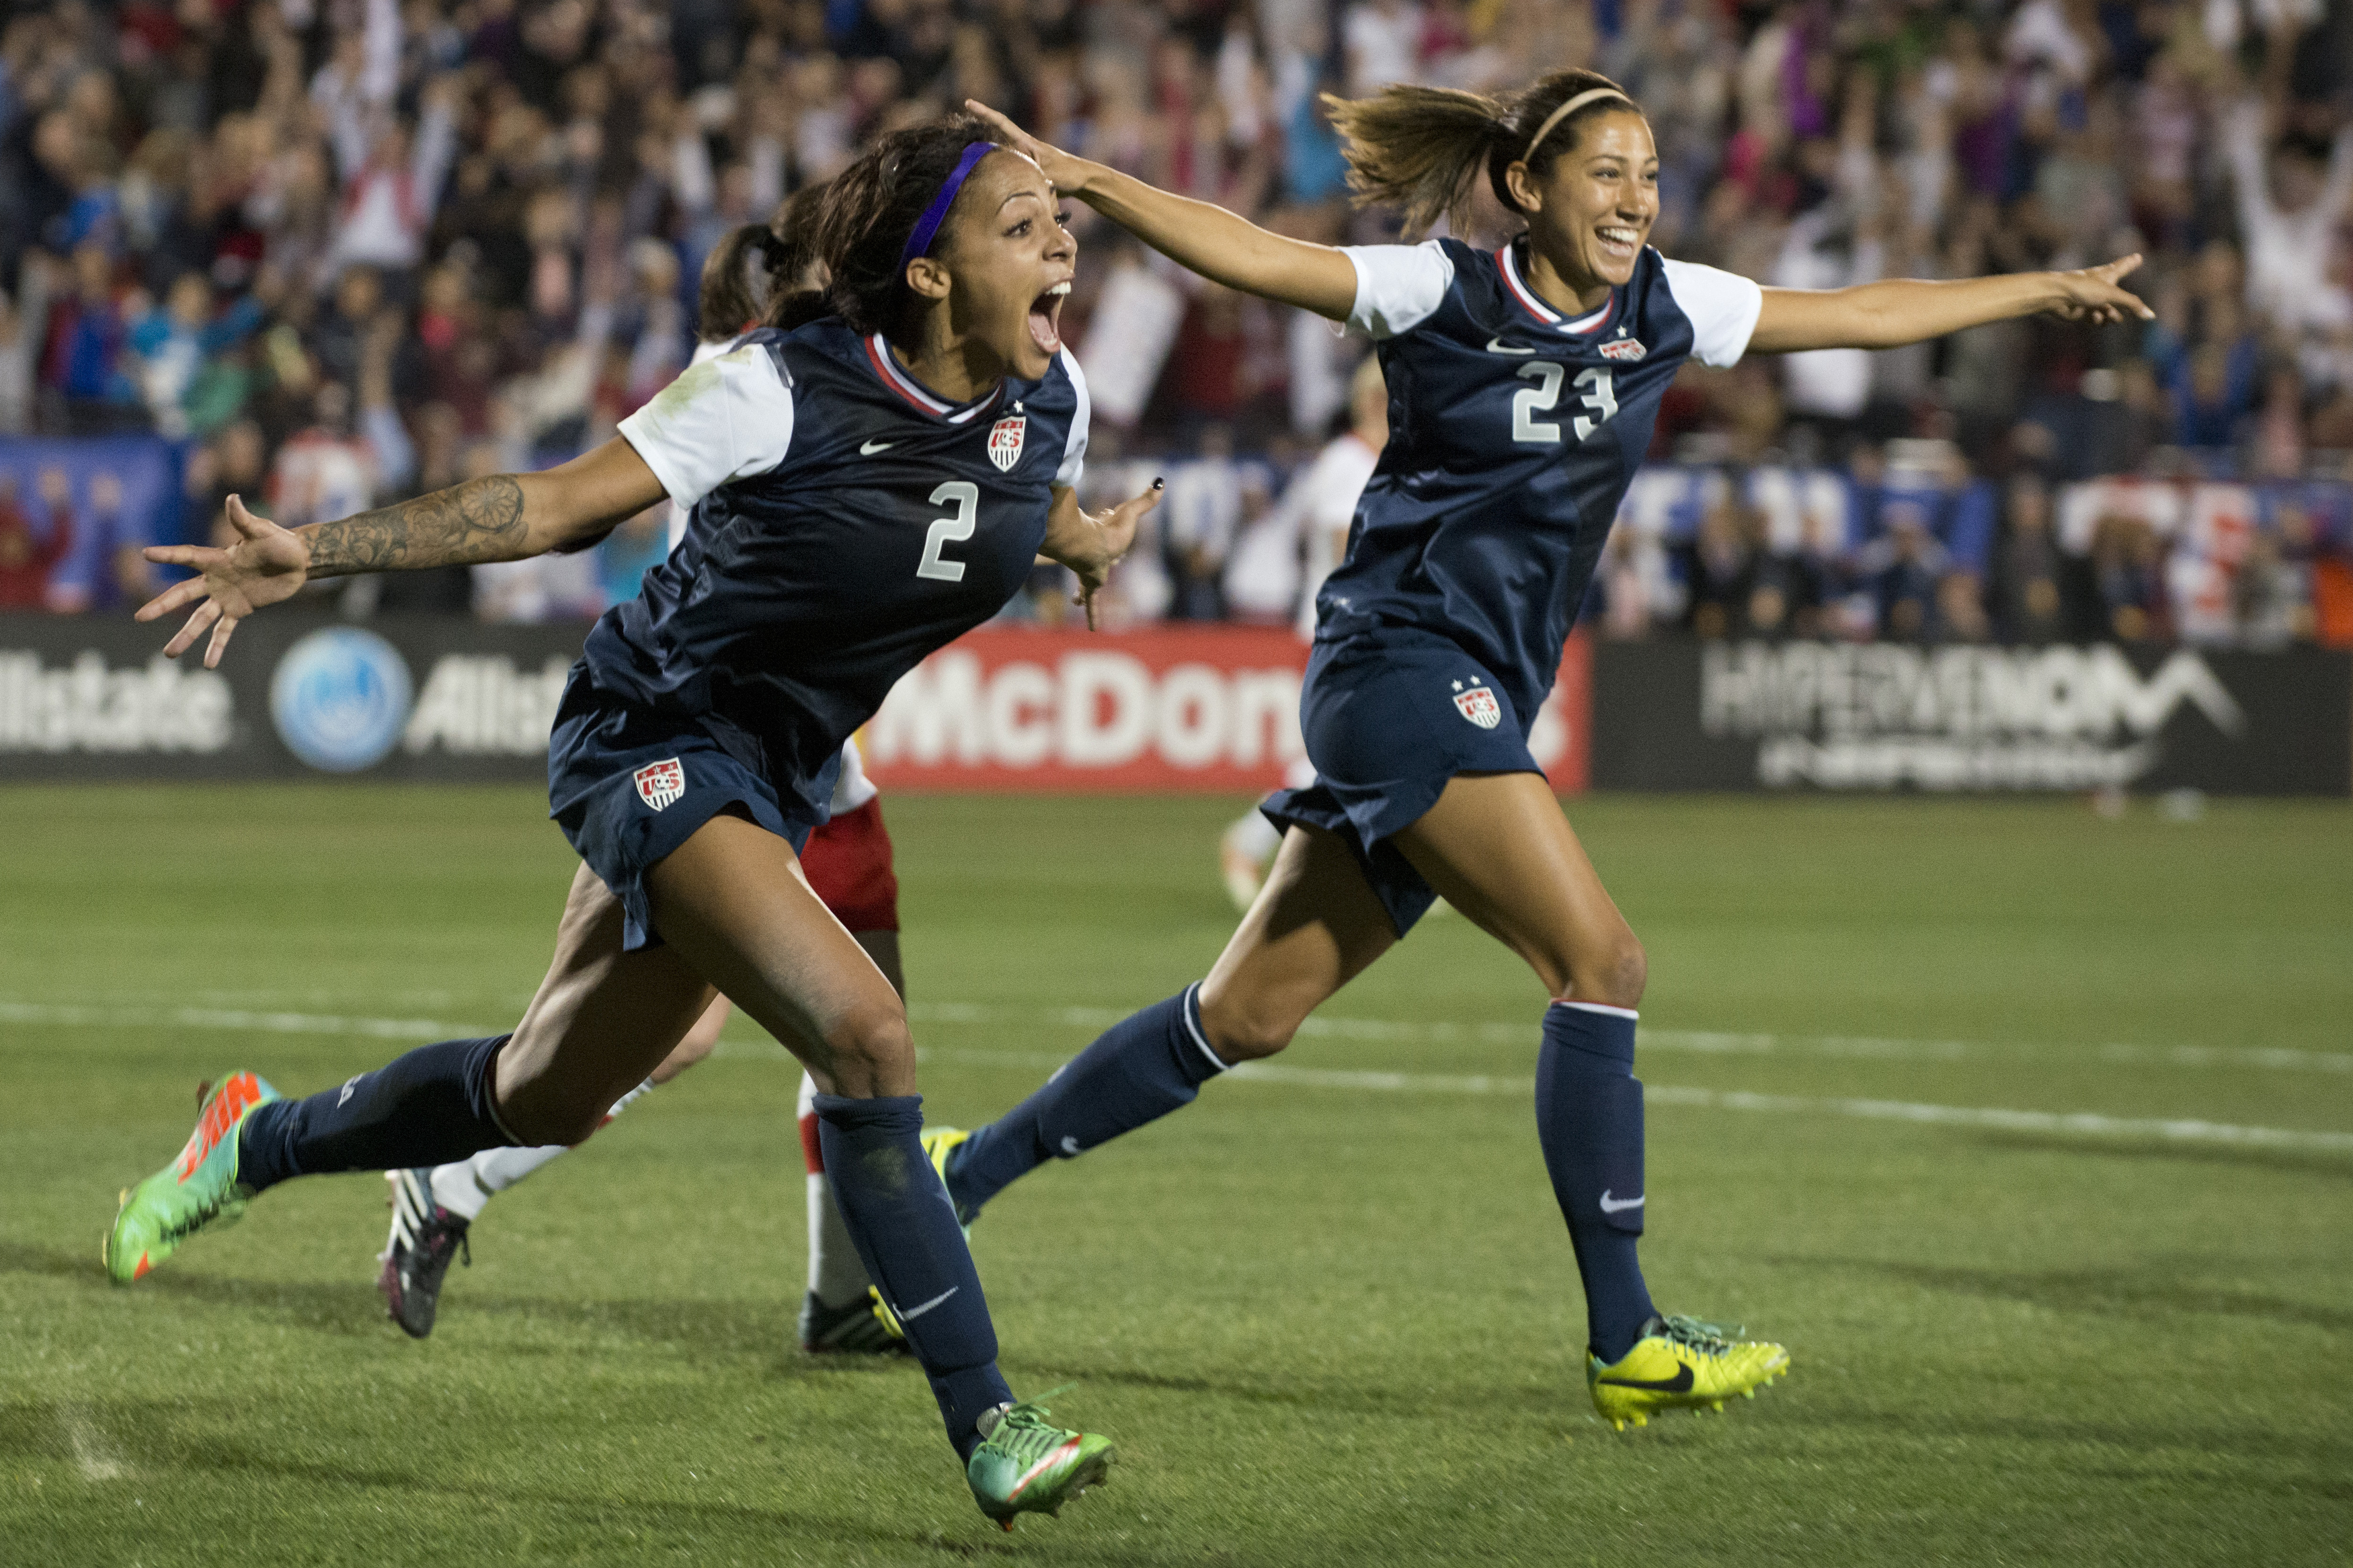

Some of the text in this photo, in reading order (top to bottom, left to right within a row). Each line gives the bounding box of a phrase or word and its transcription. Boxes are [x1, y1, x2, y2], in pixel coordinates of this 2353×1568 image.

[1512, 360, 1618, 442] 23
[916, 481, 979, 582] 2
[0, 649, 233, 753] llstate
